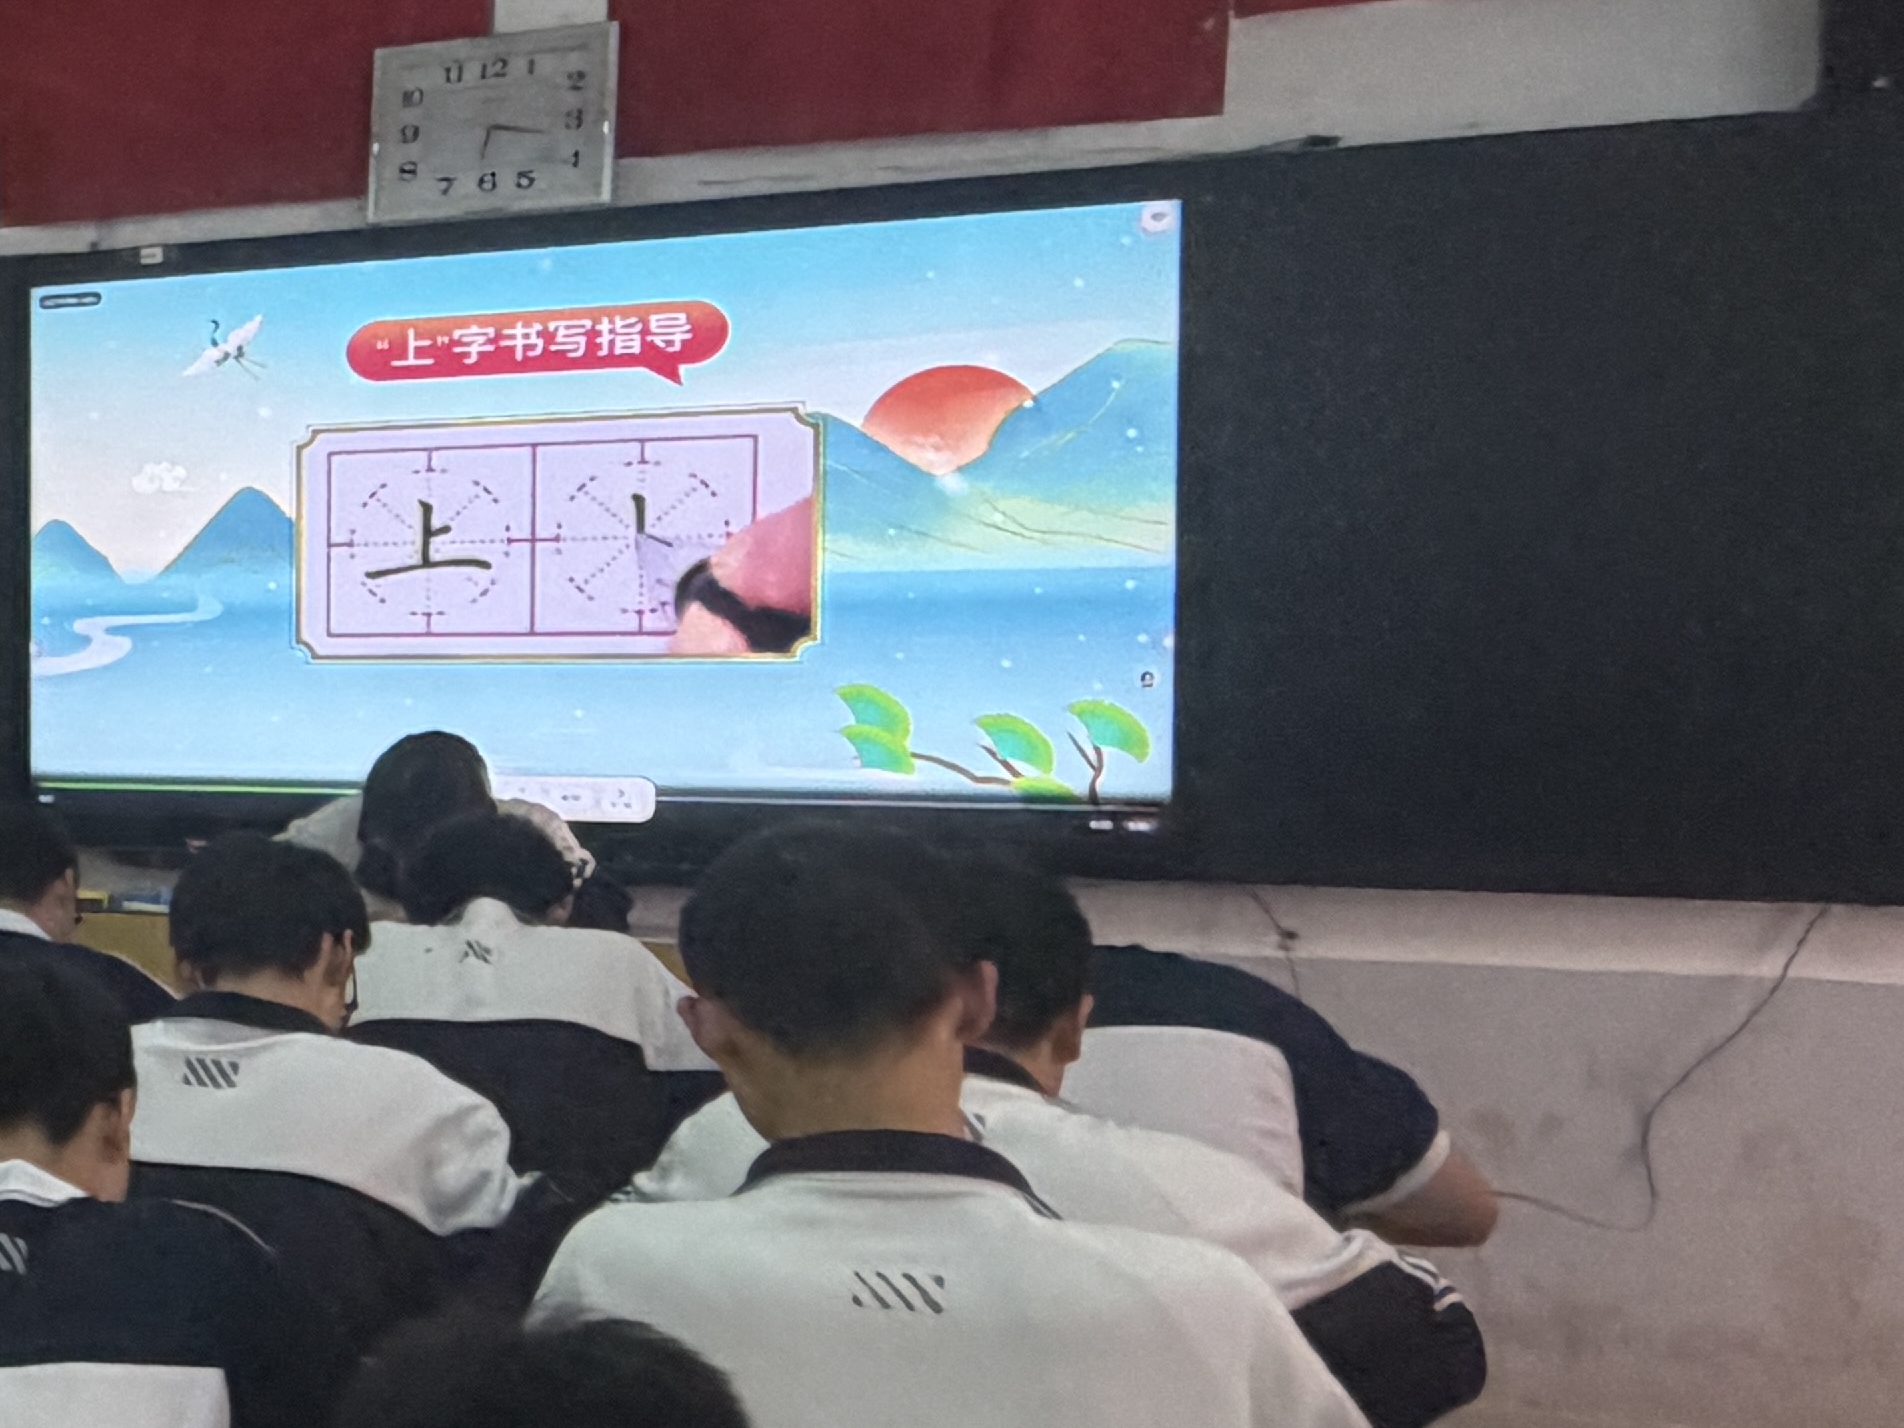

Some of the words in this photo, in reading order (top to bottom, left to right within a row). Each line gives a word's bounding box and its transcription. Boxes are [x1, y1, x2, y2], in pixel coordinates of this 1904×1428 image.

[480, 58, 508, 79] 12
[527, 58, 536, 75] 1
[436, 175, 457, 195] 7
[477, 171, 497, 192] 6
[515, 170, 535, 190] 5
[374, 312, 692, 367] “上”字书写指导
[364, 498, 492, 580] 上
